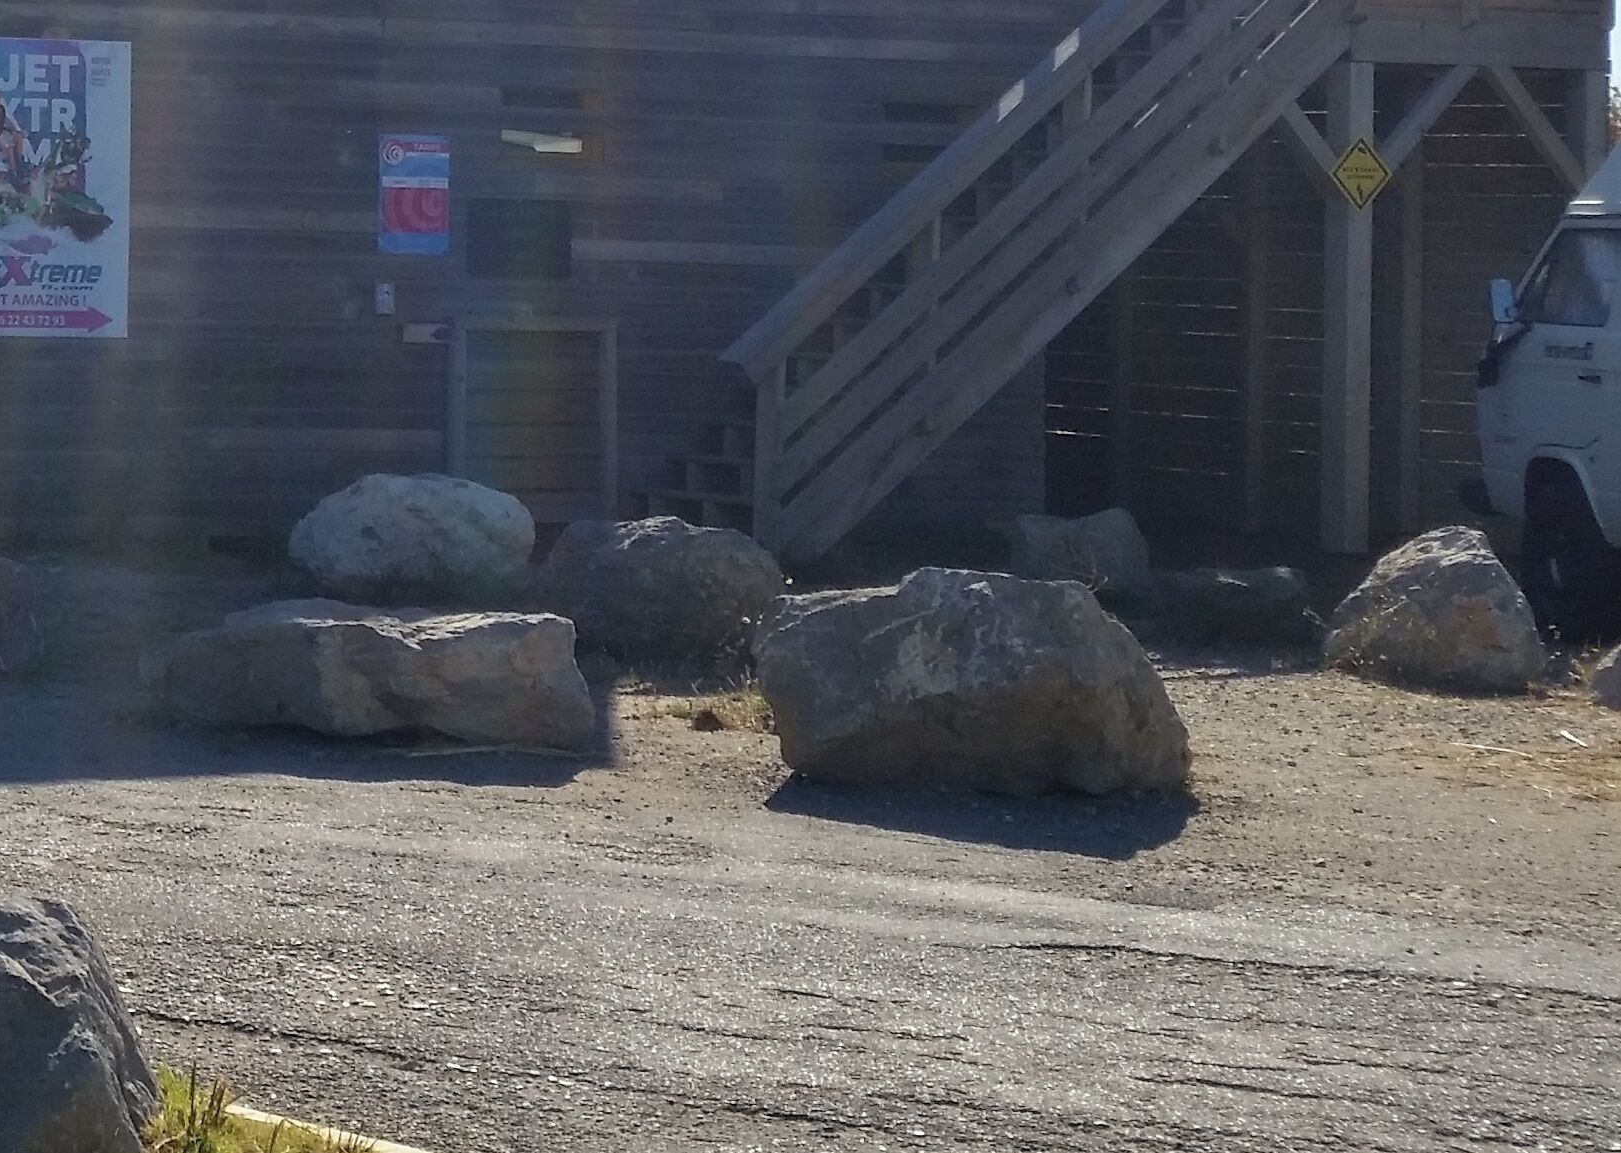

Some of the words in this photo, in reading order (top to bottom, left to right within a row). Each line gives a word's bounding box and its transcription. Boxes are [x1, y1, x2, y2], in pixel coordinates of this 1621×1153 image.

[12, 293, 80, 307] AMAZING
[8, 315, 20, 326] 22
[38, 315, 50, 326] 72
